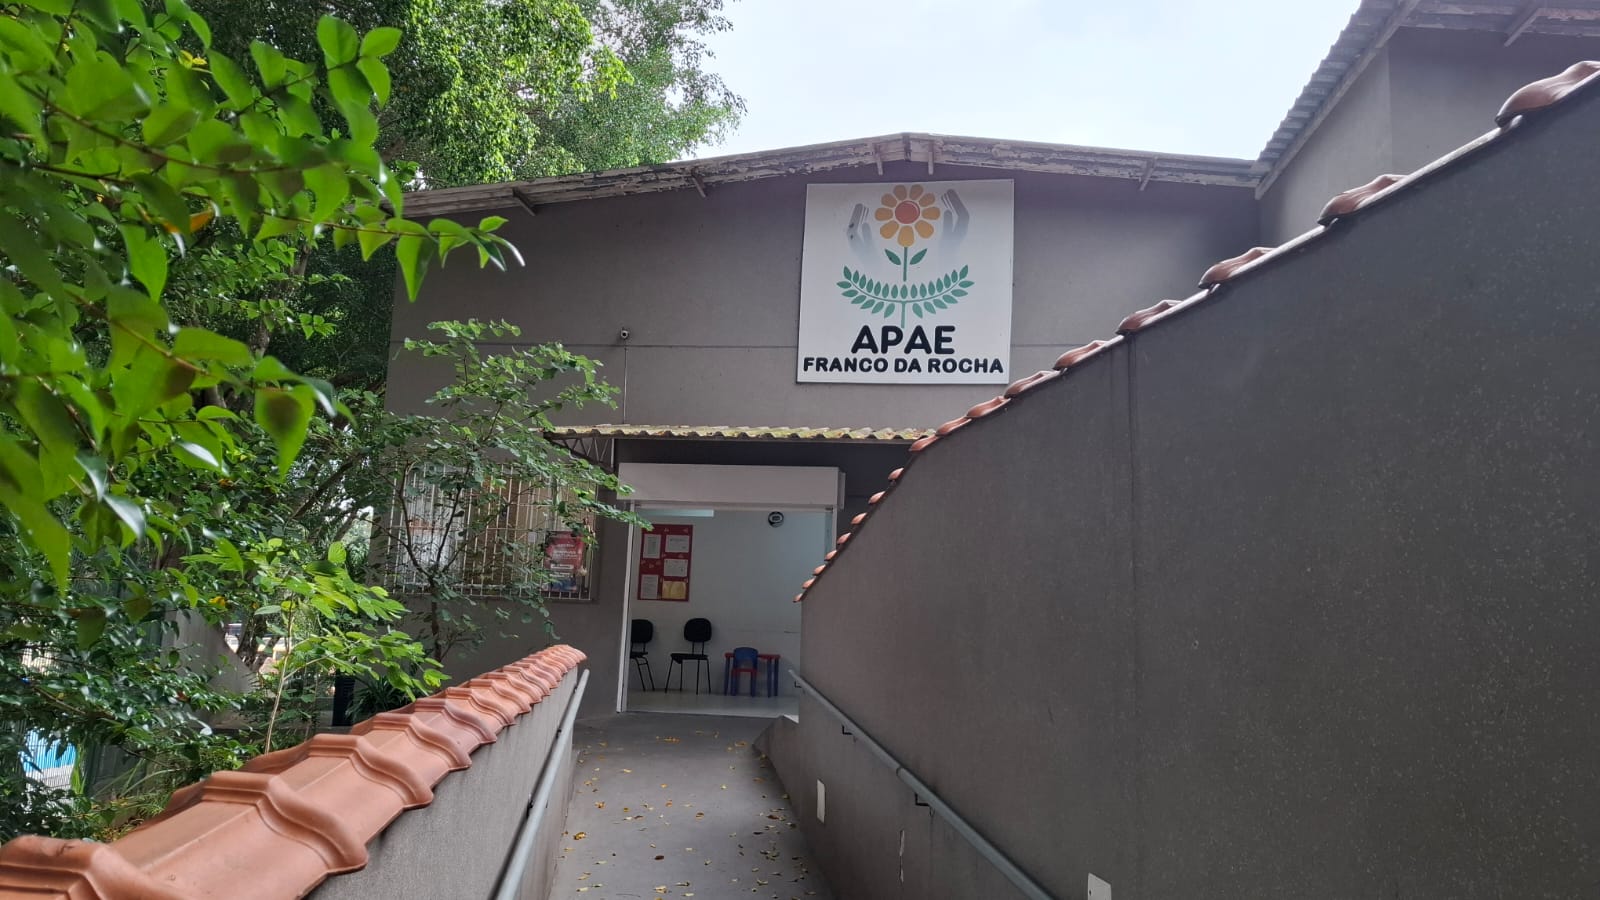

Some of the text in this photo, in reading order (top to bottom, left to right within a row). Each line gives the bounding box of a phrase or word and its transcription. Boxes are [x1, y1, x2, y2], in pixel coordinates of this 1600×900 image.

[851, 325, 955, 354] APAE
[803, 357, 1003, 373] FRANCO DA ROCHA
